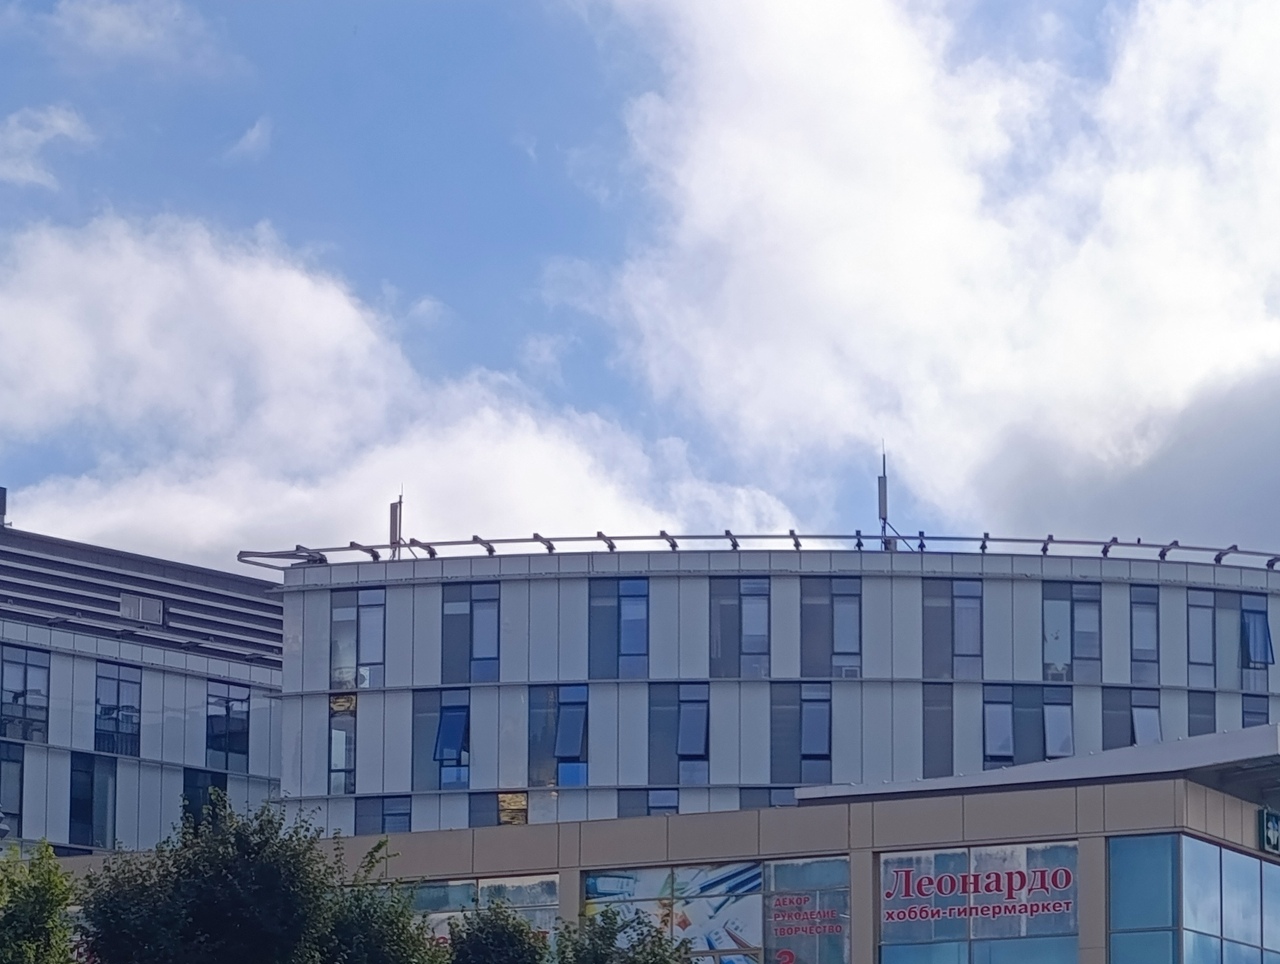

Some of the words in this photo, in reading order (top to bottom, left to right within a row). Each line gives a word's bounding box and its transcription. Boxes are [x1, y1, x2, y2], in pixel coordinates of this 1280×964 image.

[885, 866, 1072, 900] Леонардо
[774, 896, 810, 907] ДЕКОР
[774, 909, 837, 922] РУКОДЕЛИЕ
[885, 901, 1072, 922] хобби-гипермаркет
[774, 924, 842, 936] ТВОРЧЕСТВО
